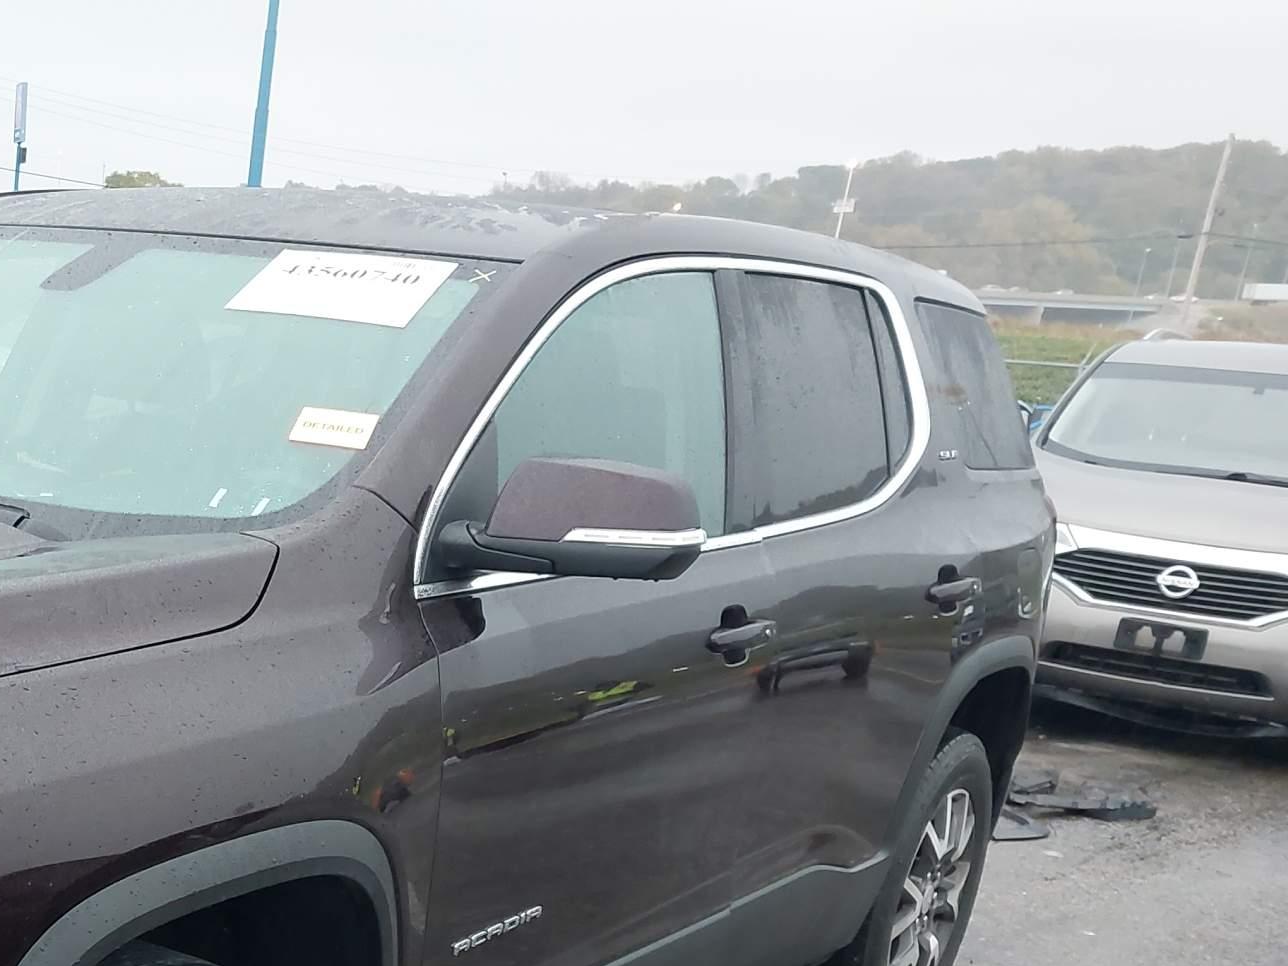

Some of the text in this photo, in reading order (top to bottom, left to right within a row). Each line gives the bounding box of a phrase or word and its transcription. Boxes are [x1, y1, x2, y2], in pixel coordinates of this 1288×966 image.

[281, 263, 422, 286] 43560740
[302, 420, 365, 434] DETAILED
[450, 904, 543, 957] ACADIA
